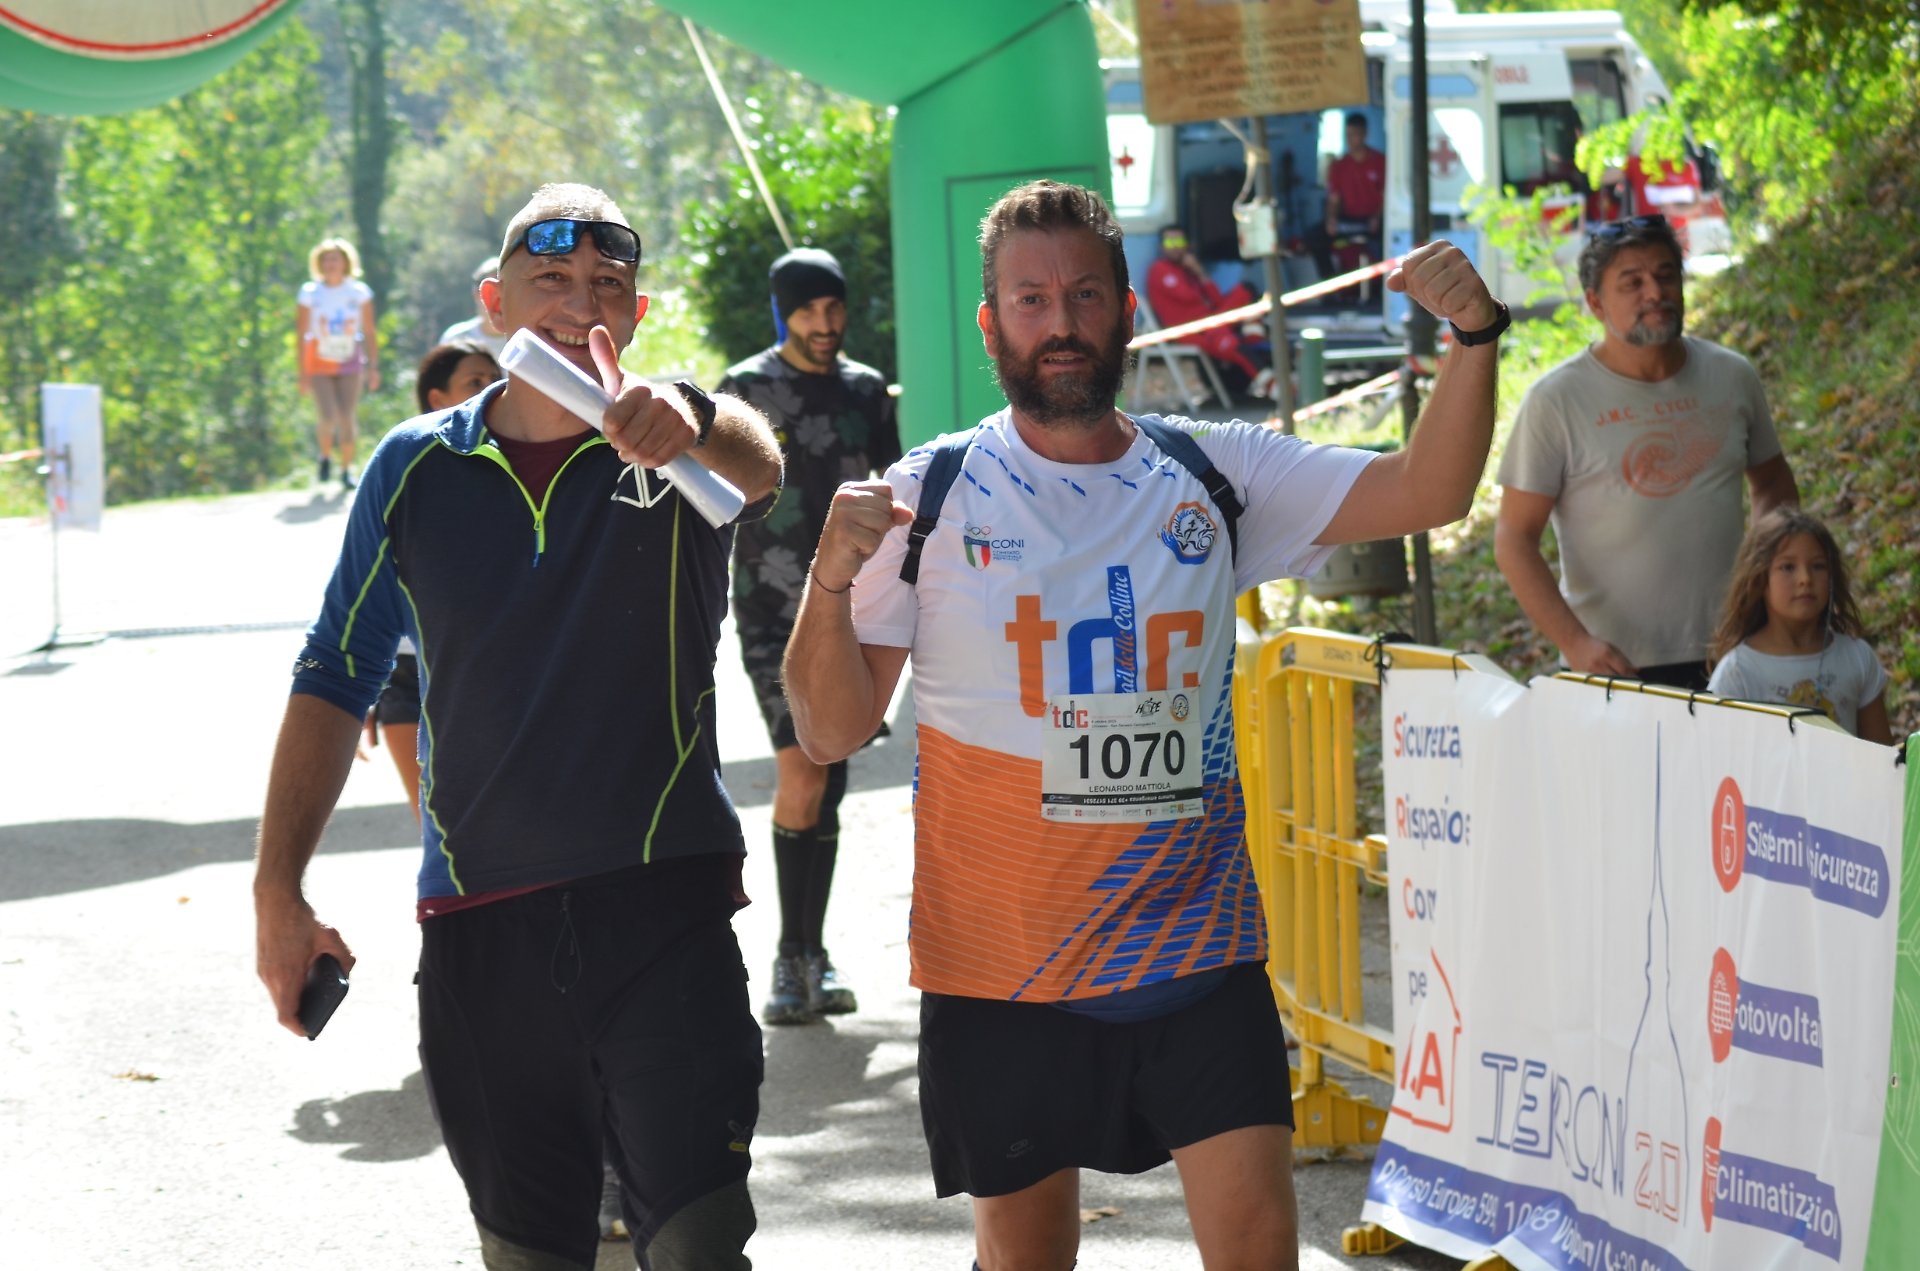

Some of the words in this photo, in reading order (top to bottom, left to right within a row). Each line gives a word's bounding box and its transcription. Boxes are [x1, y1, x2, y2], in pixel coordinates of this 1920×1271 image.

[991, 539, 1025, 549] CONI
[1052, 700, 1089, 729] tdc
[1069, 729, 1186, 780] 1070
[1089, 785, 1134, 793] LEONARDO
[1135, 781, 1171, 791] MATTIOLA
[1385, 1165, 1432, 1203] Corso
